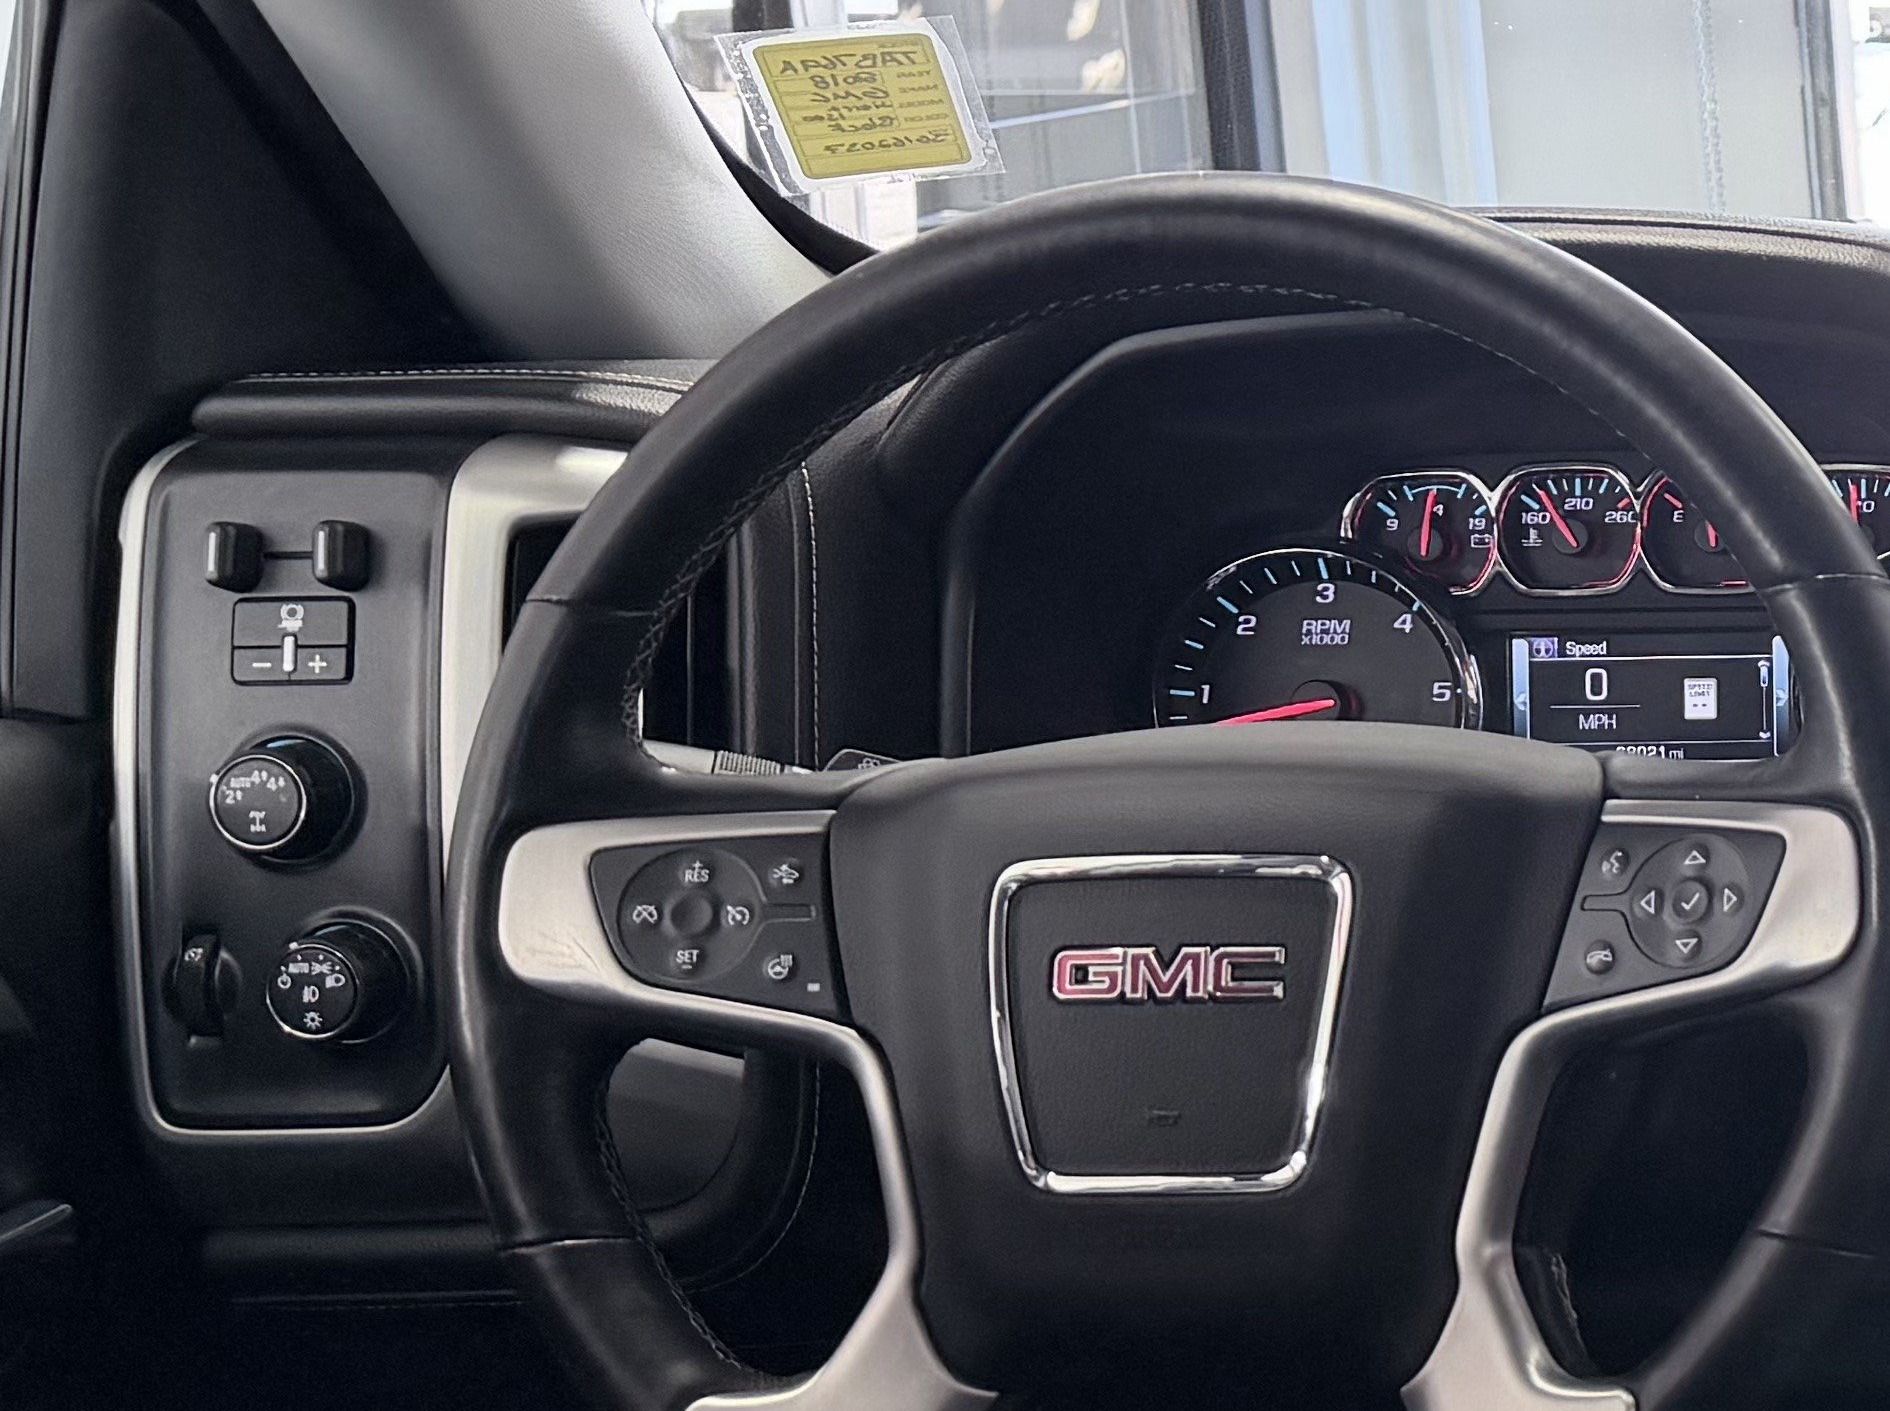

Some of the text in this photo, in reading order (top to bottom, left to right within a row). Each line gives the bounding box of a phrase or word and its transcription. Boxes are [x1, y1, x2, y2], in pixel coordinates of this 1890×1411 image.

[1563, 497, 1594, 510] 210
[1385, 518, 1399, 531] 9
[1468, 517, 1487, 530] 19
[1520, 511, 1551, 525] 160
[1315, 583, 1336, 603] 3
[1236, 614, 1257, 635] 2
[1301, 619, 1351, 634] RPM
[1393, 613, 1413, 633] 4
[1565, 641, 1607, 658] Speed
[1431, 682, 1453, 702] 5
[1584, 667, 1608, 701] 0
[1201, 684, 1210, 704] 1
[1578, 713, 1617, 730] MPH
[684, 866, 710, 882] RES
[675, 949, 700, 963] SET
[1053, 946, 1286, 1000] GMC
